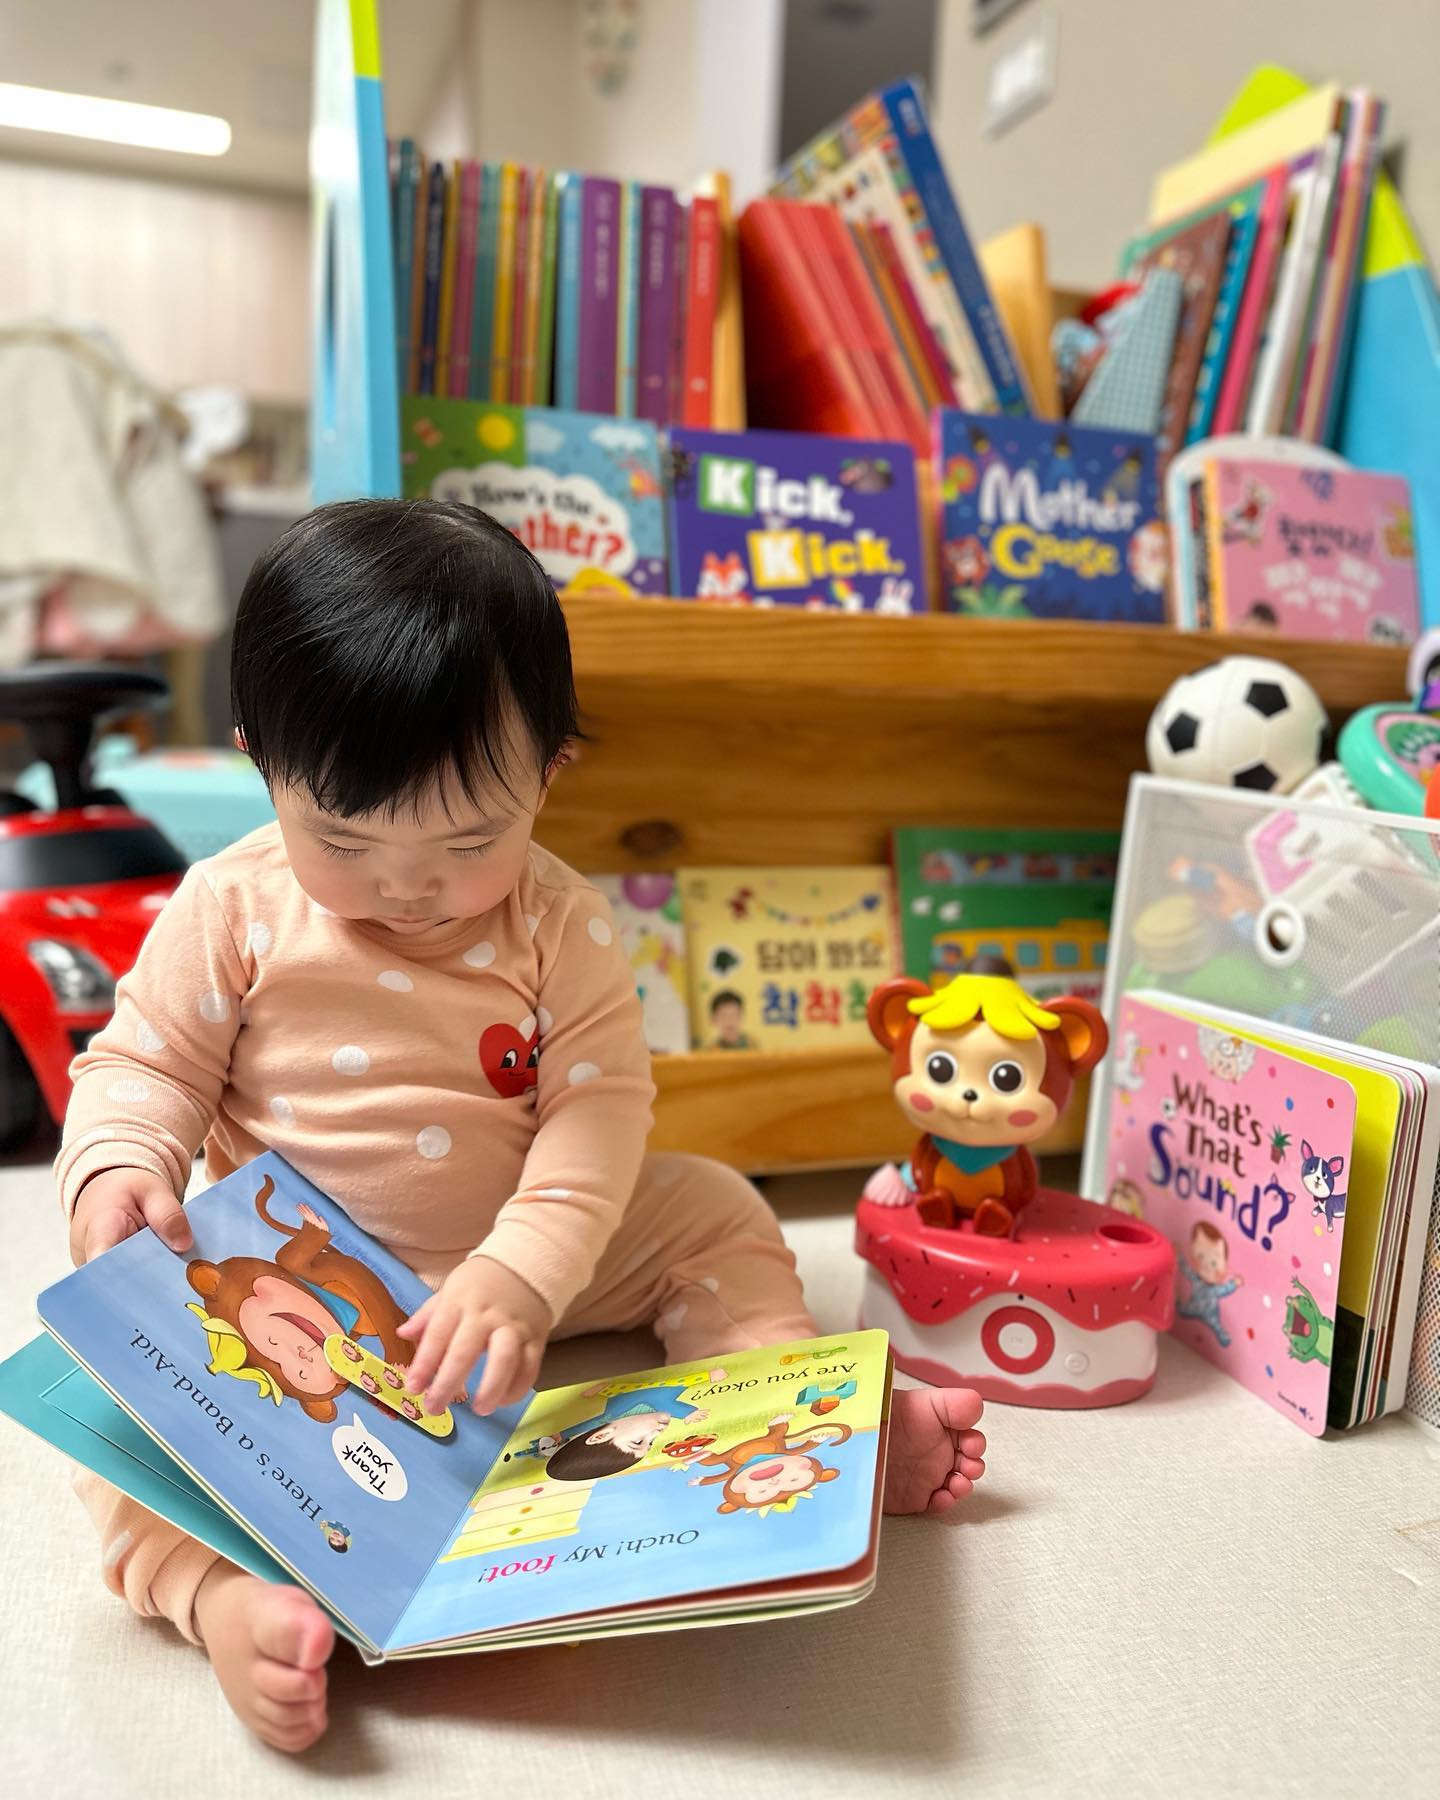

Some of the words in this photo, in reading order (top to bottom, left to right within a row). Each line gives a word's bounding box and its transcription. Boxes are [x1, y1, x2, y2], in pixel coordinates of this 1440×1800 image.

[553, 491, 593, 516] the
[979, 461, 1141, 532] Mother
[990, 522, 1120, 579] Goose
[1171, 1071, 1264, 1147] What's
[1185, 1119, 1247, 1180] That
[1147, 1122, 1291, 1252] Sound?
[129, 1327, 235, 1438] Band-Aid.
[766, 1367, 810, 1385] you
[816, 1362, 859, 1376] Are
[690, 1378, 759, 1402] okay?
[238, 1433, 255, 1451] a
[355, 1441, 394, 1474] you!
[341, 1445, 384, 1495] Thank
[256, 1452, 323, 1522] Here's
[563, 1544, 609, 1564] My
[615, 1529, 700, 1556] Ouch!
[477, 1553, 559, 1584] foot!
